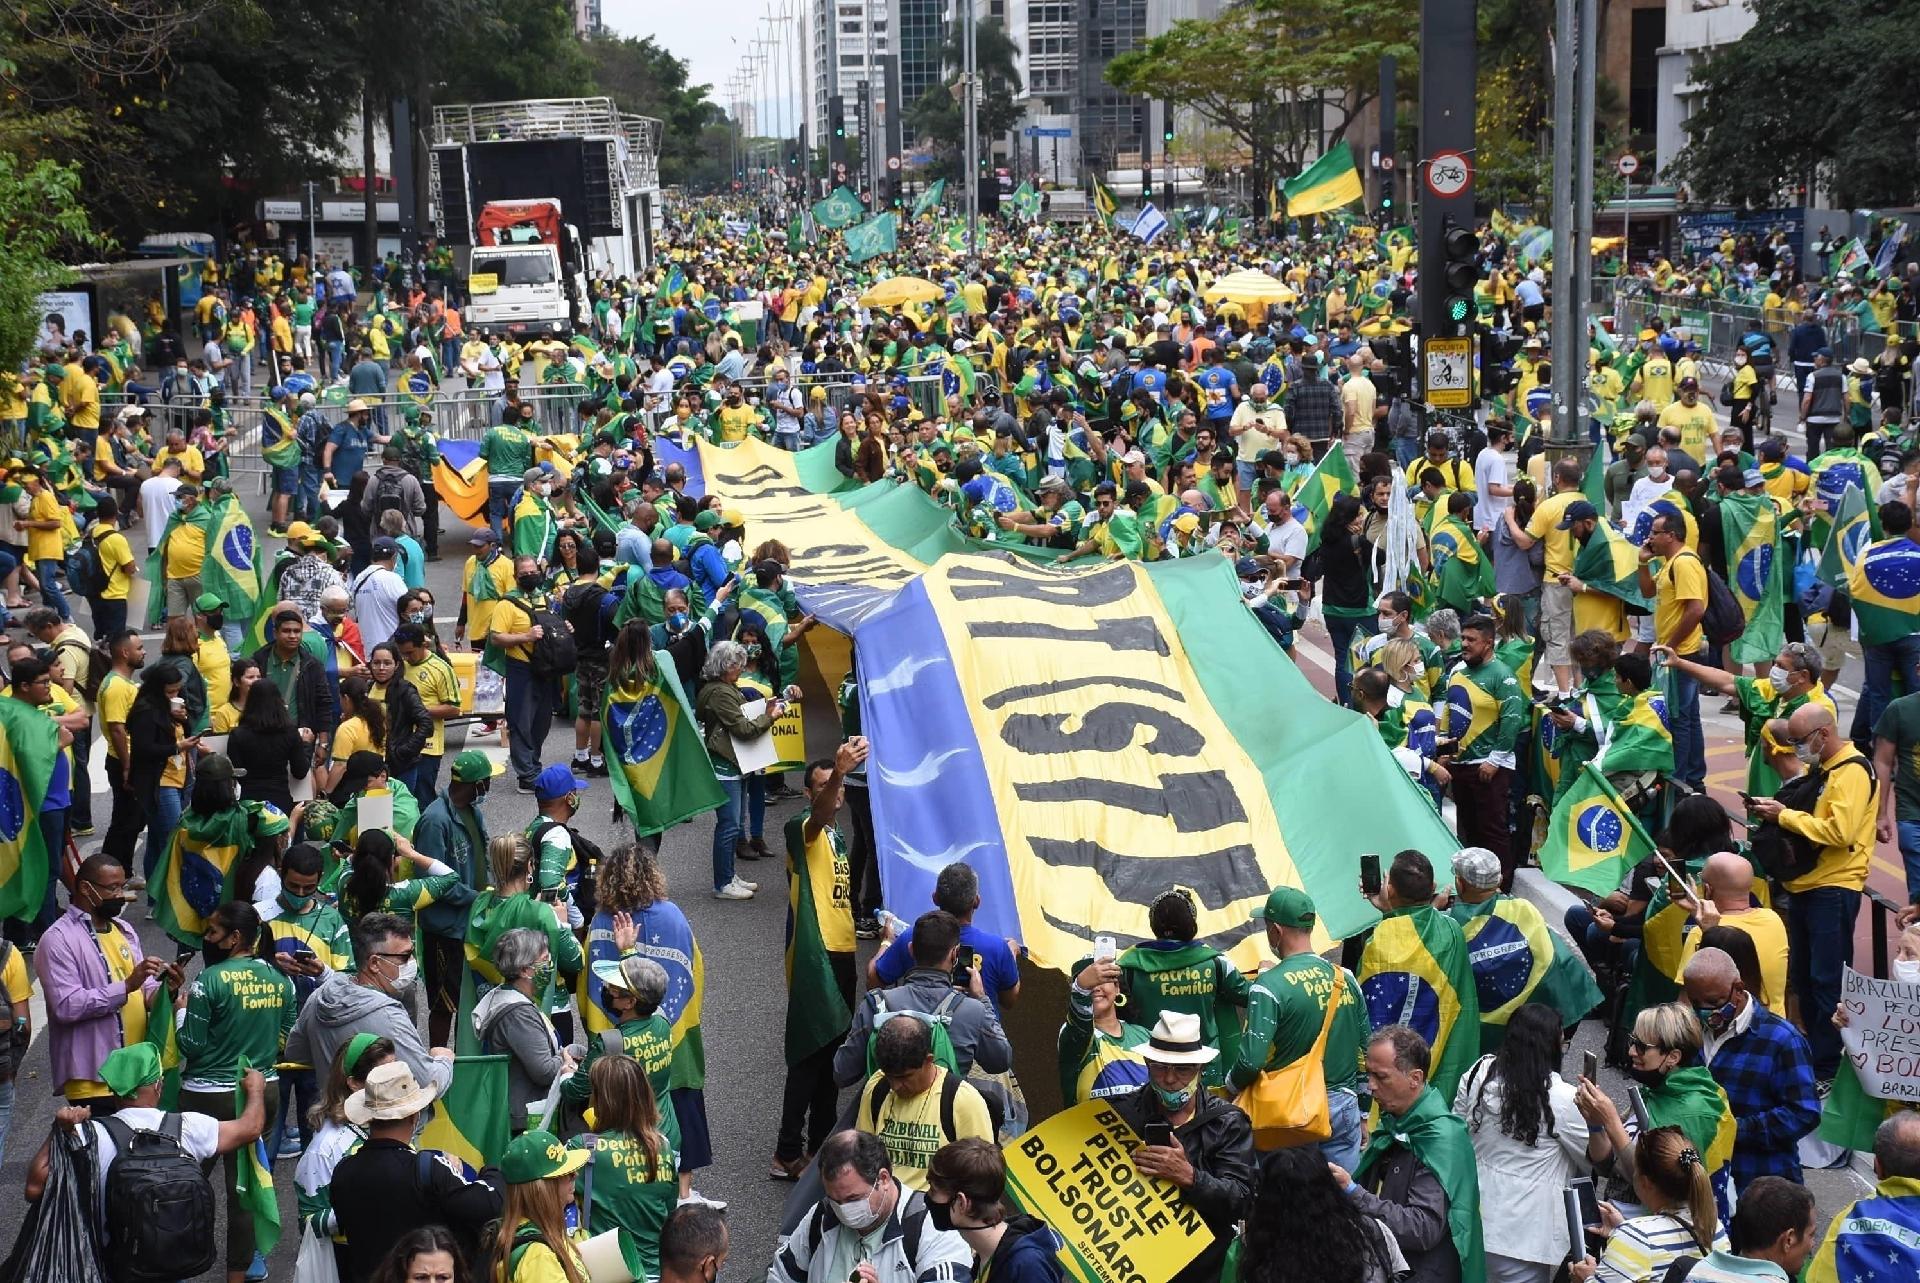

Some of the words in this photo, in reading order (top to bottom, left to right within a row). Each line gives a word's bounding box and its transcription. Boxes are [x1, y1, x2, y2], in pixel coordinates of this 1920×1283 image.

[428, 152, 446, 239] DEMOLIDOR
[606, 142, 622, 229] DEMOLIDOR
[220, 969, 258, 984] Deus,
[1204, 967, 1213, 979] e
[1283, 966, 1330, 986] Deus,
[1160, 978, 1214, 996] Família
[623, 1031, 656, 1050] Deus,
[1085, 1132, 1170, 1236] PEOPLE
[1071, 1151, 1145, 1241] TRUST
[1848, 1219, 1893, 1235] ORDEM
[1898, 1228, 1909, 1242] E
